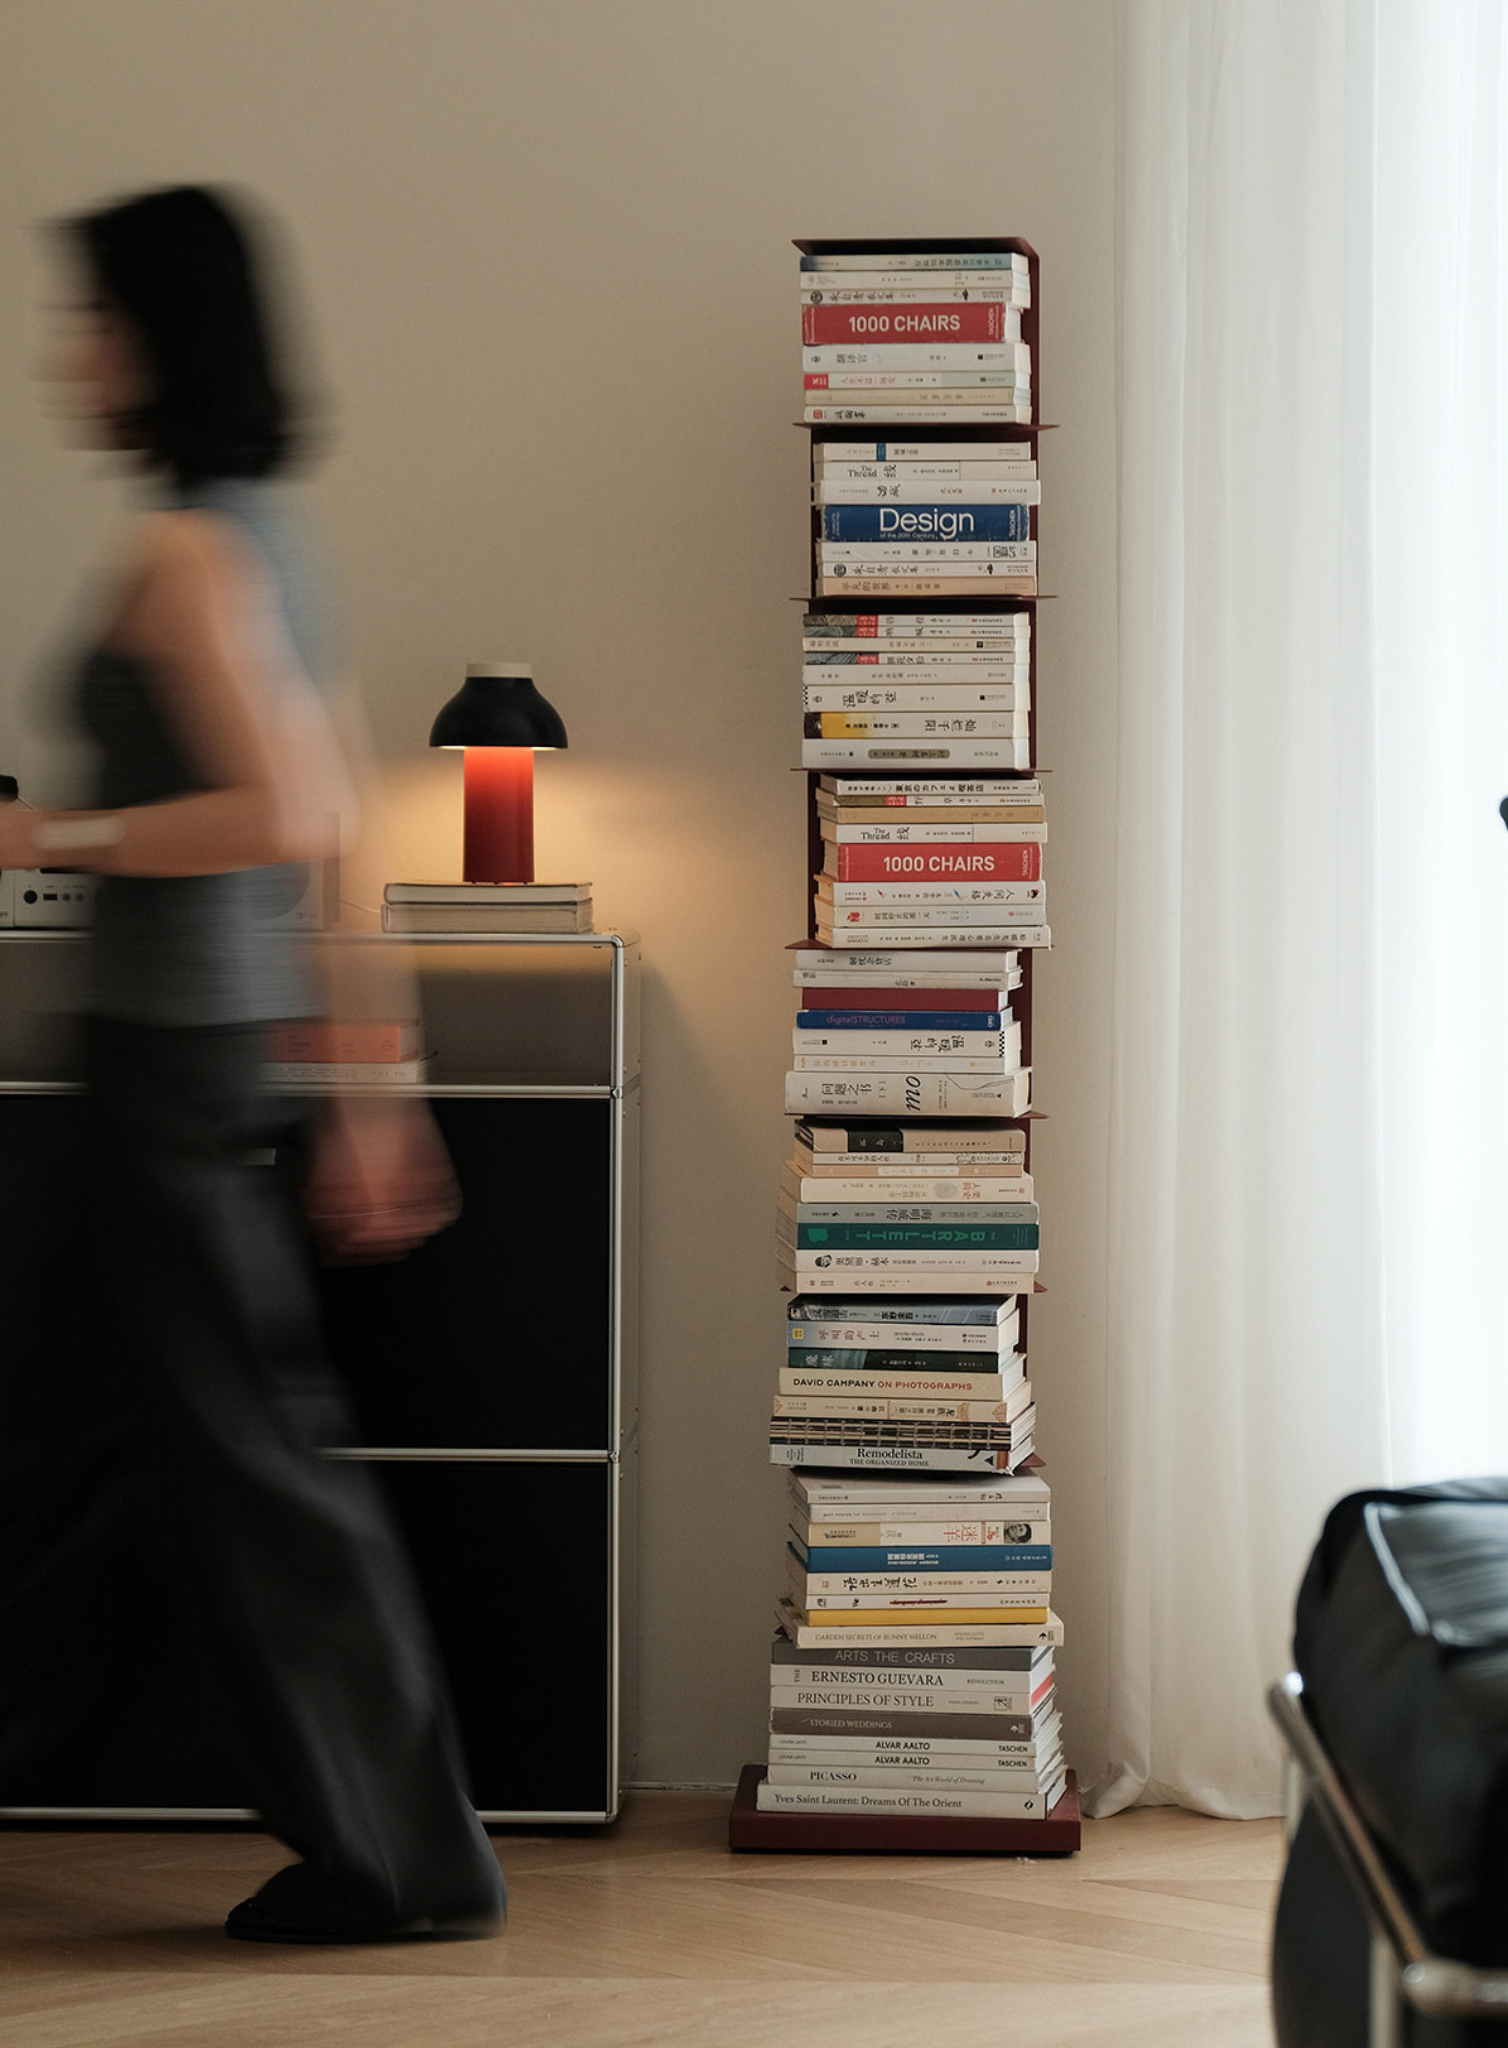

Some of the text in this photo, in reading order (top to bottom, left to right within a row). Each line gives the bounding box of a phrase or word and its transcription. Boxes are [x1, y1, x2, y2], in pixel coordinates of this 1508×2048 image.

[849, 314, 960, 332] 1000 CHAIRS
[847, 469, 878, 478] Thread
[879, 508, 975, 540] Design
[843, 689, 897, 707] 温暖的弦
[925, 719, 977, 732] 灿烂千阳
[860, 831, 890, 840] Thread
[883, 855, 995, 872] 1000 CHAIRS
[971, 889, 1015, 900] 人间失格
[826, 1015, 906, 1025] digitalSTRUCTURES
[910, 1035, 965, 1052] 温暖的弦
[886, 1208, 932, 1221] 海明威传
[855, 1230, 985, 1242] BARTLETT
[793, 1378, 973, 1391] DAVID CAMPANY ON PHOTOGRAPHS
[857, 1448, 923, 1461] Remodelista
[943, 1524, 978, 1543] 迷羊
[845, 1633, 873, 1641] SECRETS
[883, 1633, 908, 1641] BUNNY
[834, 1650, 955, 1664] ARTS THE CRAFTS
[811, 1671, 944, 1686] ERNESTO GUEVARA
[797, 1692, 870, 1705] PRINCIPLES
[873, 1694, 891, 1706] OF
[893, 1695, 934, 1707] STYLE
[809, 1719, 893, 1730] STORIED WEDDINGS
[875, 1741, 931, 1751] ALVAR AALTO
[874, 1756, 930, 1766] ALVAR AALTO
[810, 1771, 857, 1782] PICASSO
[912, 1775, 924, 1783] The
[960, 1777, 986, 1786] Drawing
[775, 1793, 963, 1808] Yves Saint Laurent: Dreams Of The Orient
